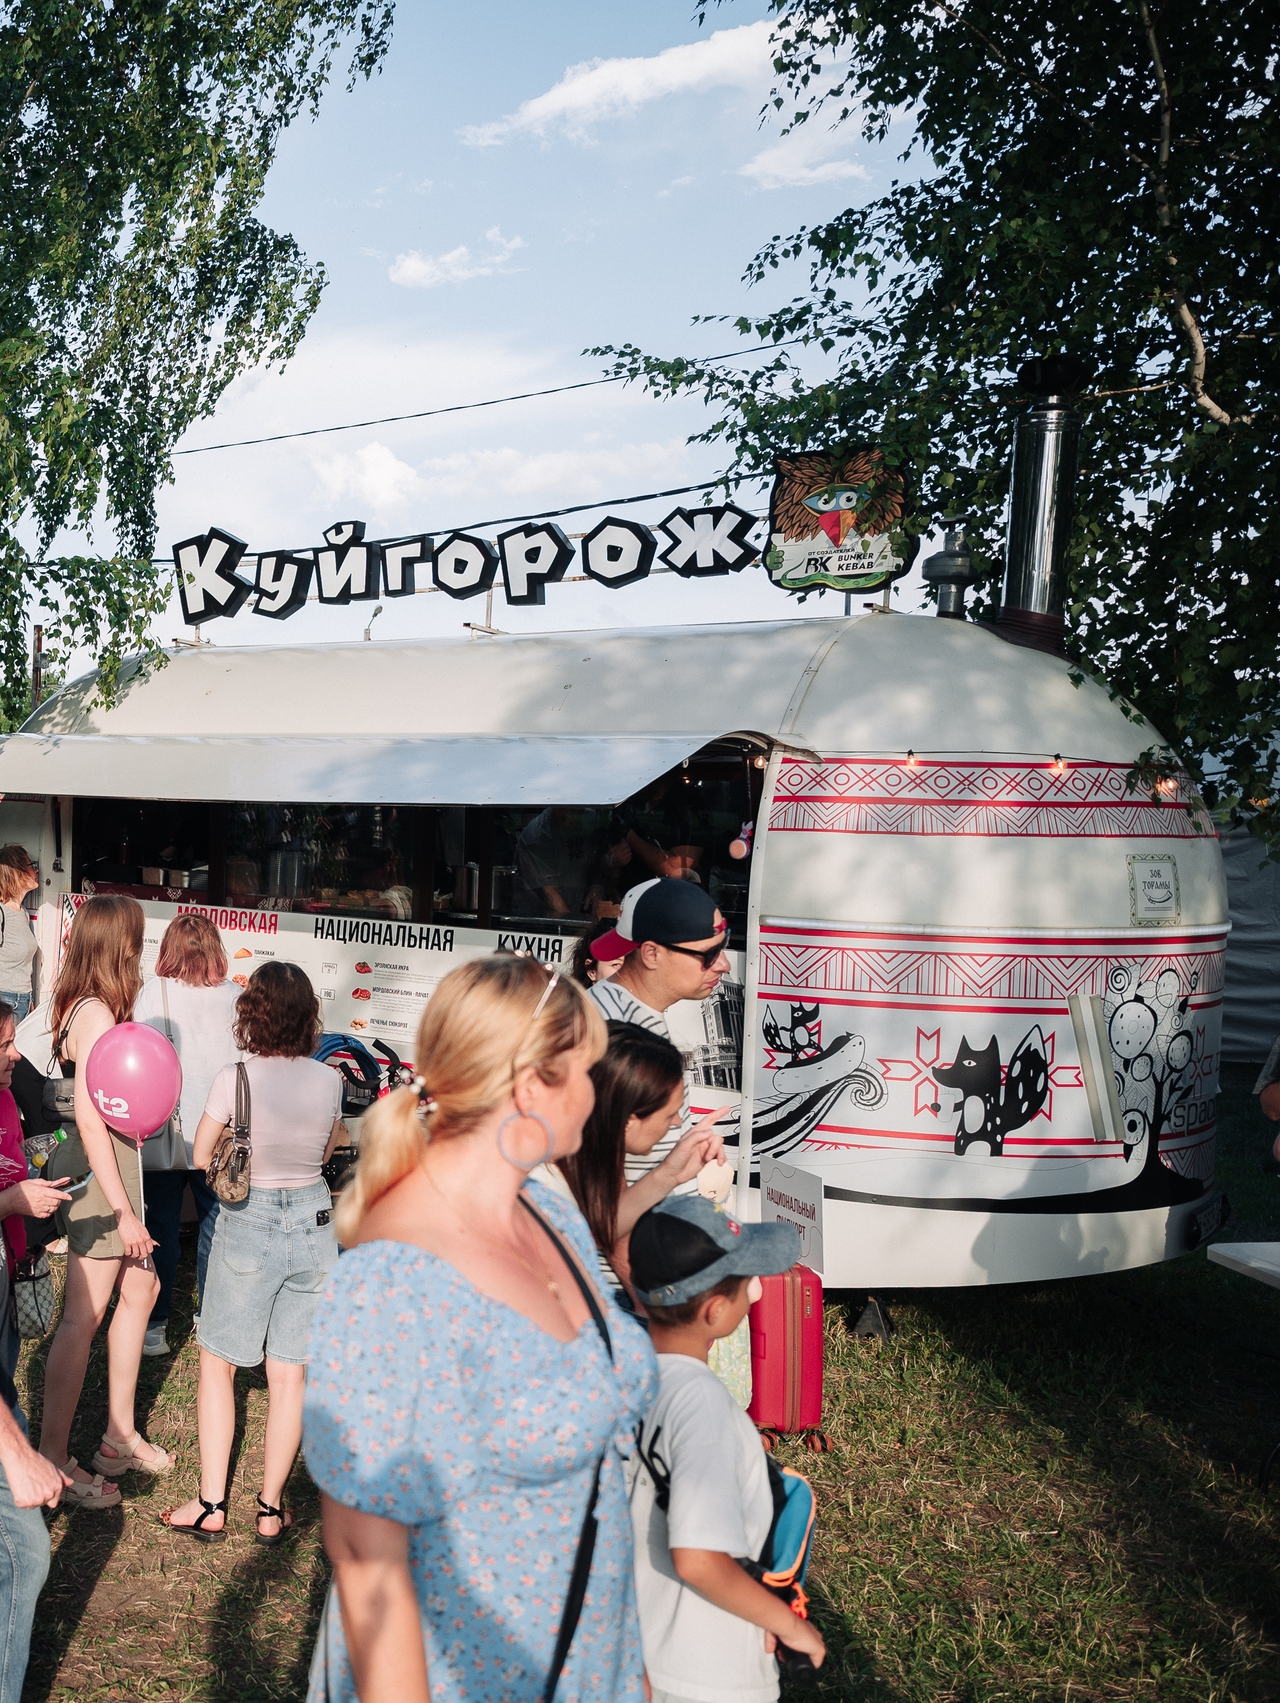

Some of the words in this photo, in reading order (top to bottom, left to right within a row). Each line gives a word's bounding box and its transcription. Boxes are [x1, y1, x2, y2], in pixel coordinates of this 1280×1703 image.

[837, 553, 874, 561] BUNKER
[837, 562, 874, 571] KEBAB
[314, 917, 455, 952] НАЦИОНАЛЬНАЯ
[498, 934, 563, 963] КУХНЯ
[93, 1088, 130, 1119] t2
[766, 1186, 816, 1222] НАЦИОНАЛЬНЫЙ
